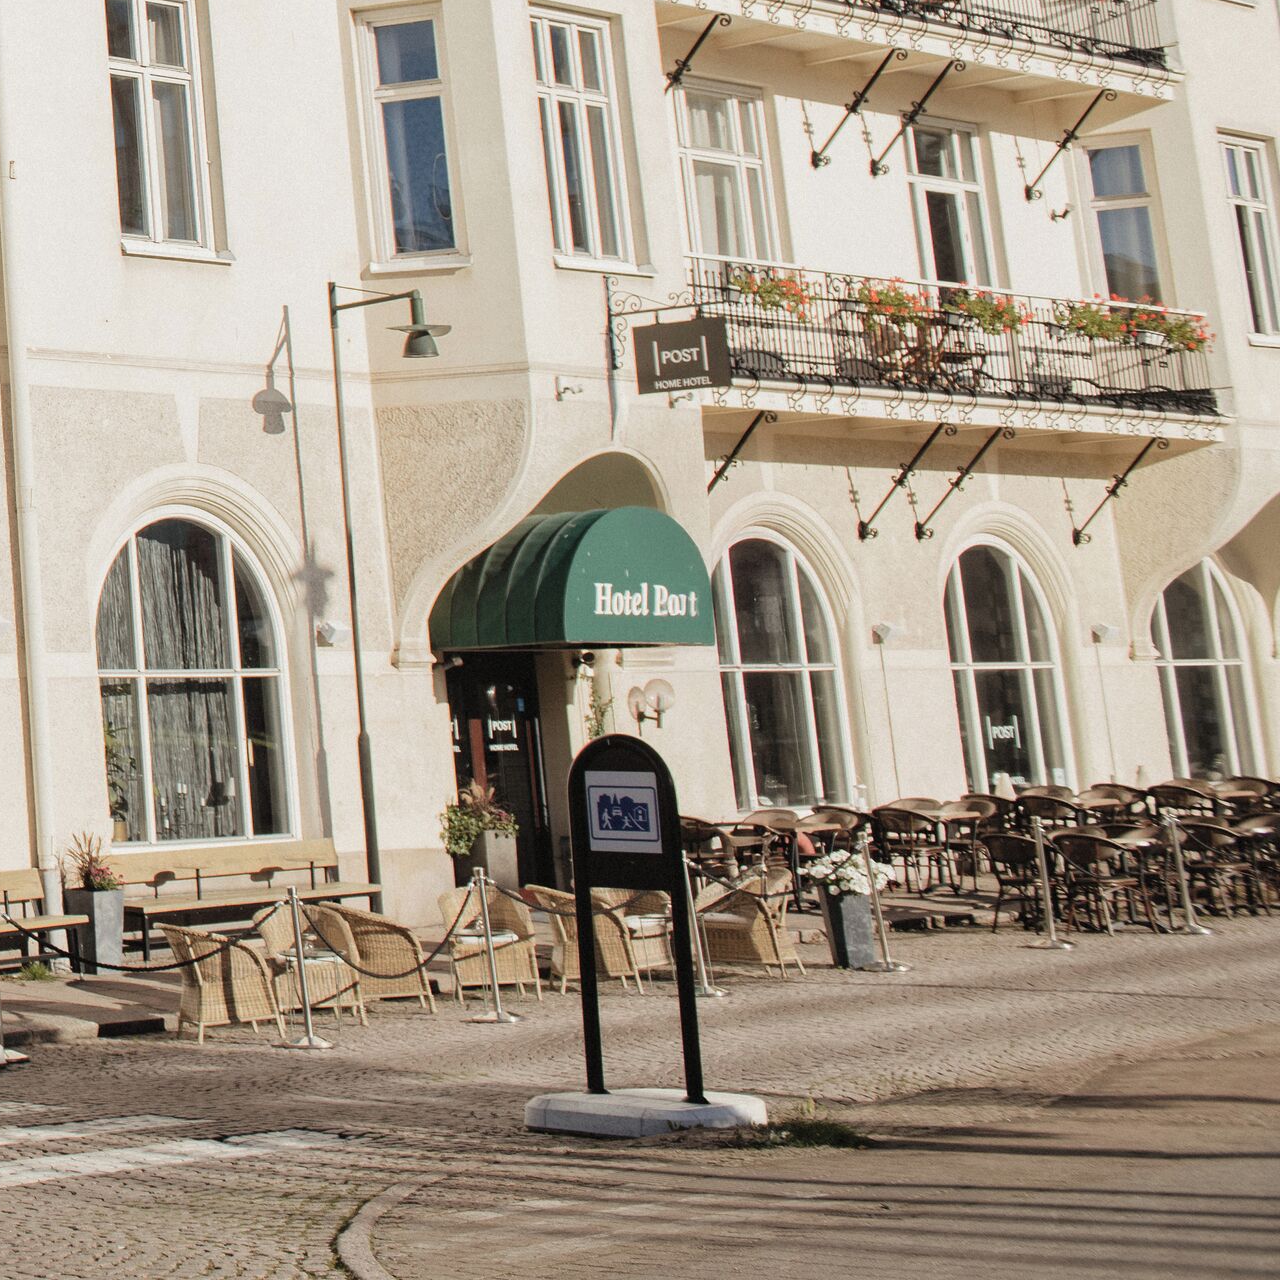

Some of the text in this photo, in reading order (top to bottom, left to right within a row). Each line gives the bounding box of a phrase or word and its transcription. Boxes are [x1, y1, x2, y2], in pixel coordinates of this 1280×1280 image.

[661, 348, 700, 364] POST
[654, 376, 713, 389] HOME HOTEL
[593, 582, 649, 616] Hotel
[492, 720, 513, 732] POST
[991, 725, 1015, 739] POST
